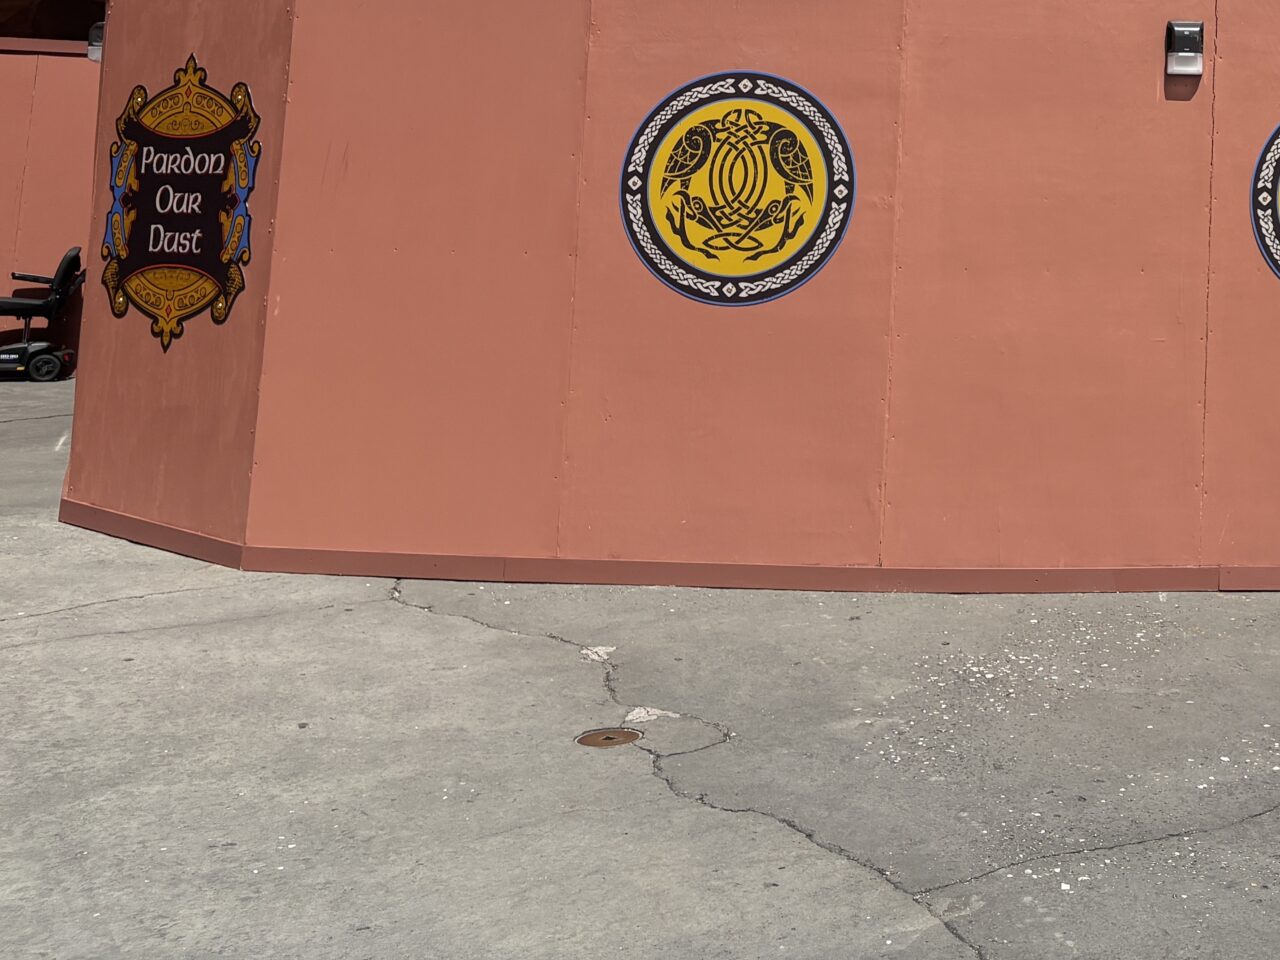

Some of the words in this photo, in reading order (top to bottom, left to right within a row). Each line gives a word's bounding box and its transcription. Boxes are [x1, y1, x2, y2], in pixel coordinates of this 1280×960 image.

[141, 146, 225, 174] Pardon
[155, 185, 202, 214] Our
[148, 224, 202, 253] Dust
